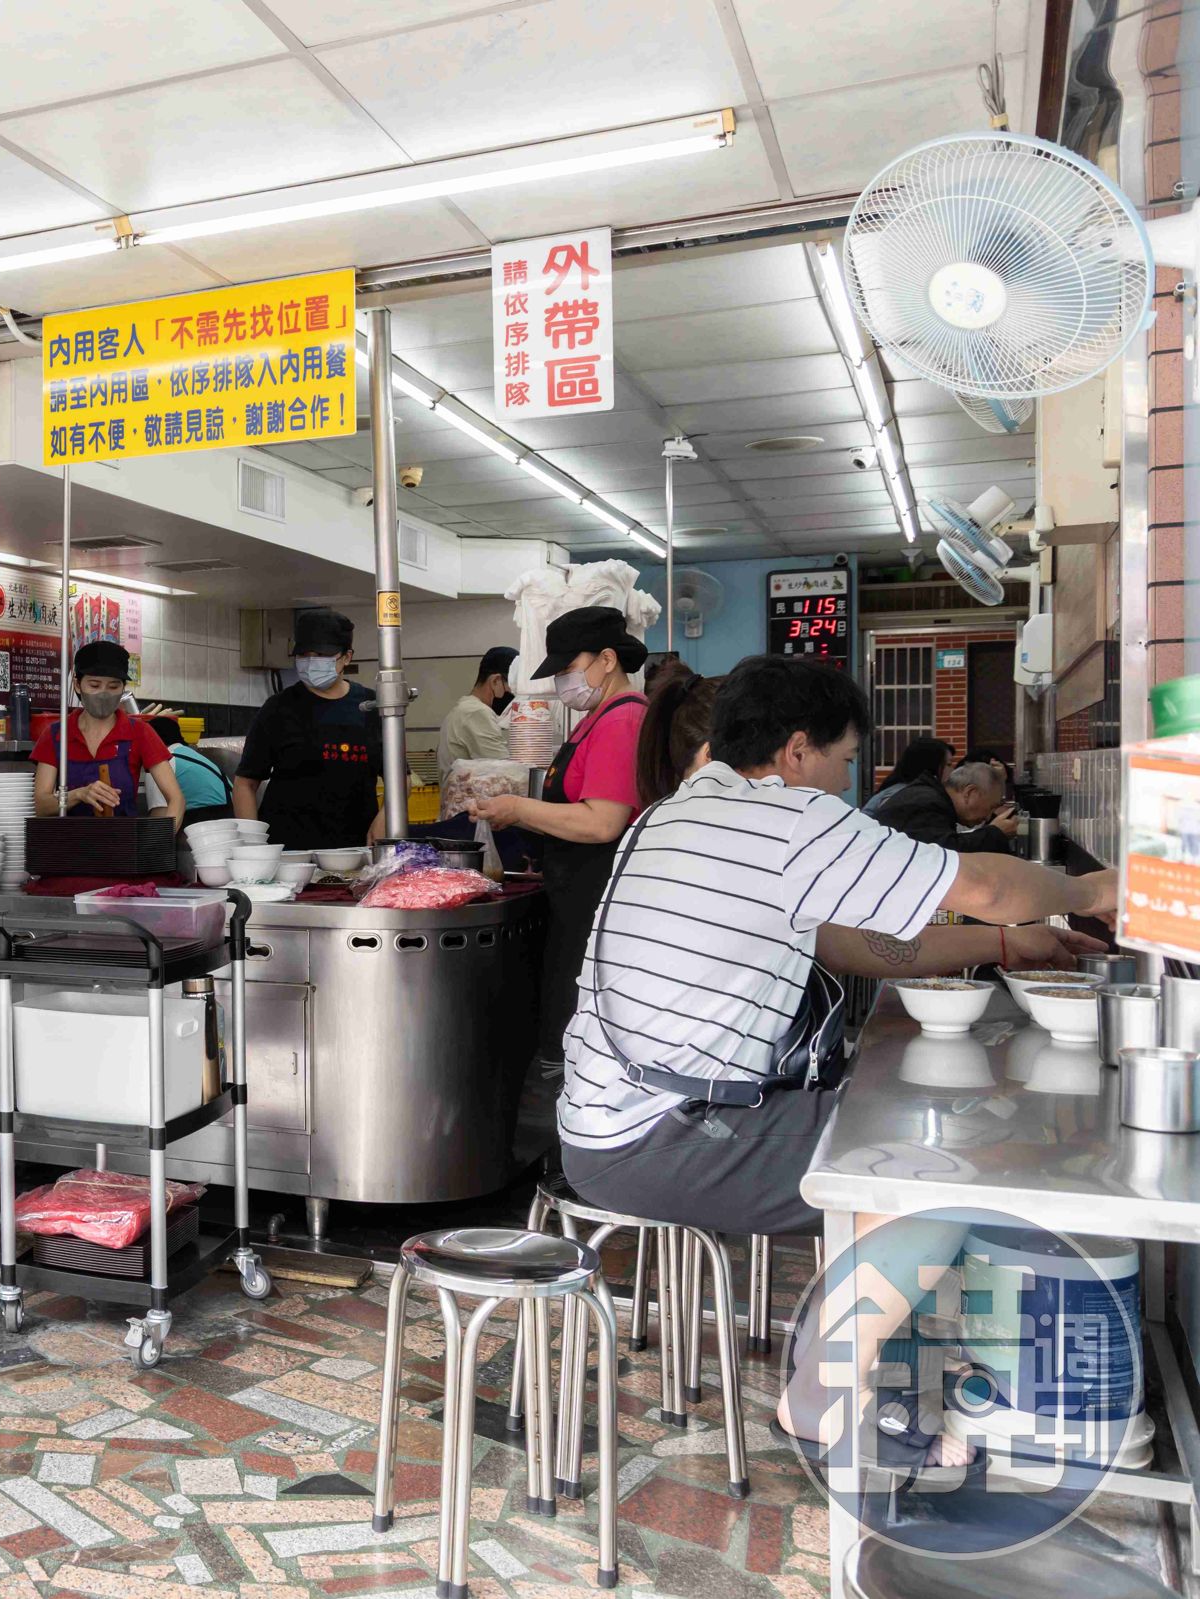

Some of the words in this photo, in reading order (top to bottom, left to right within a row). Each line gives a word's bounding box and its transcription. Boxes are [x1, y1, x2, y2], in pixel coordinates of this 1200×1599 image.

[503, 260, 530, 407] 請依序排隊
[542, 241, 602, 407] 外帶區
